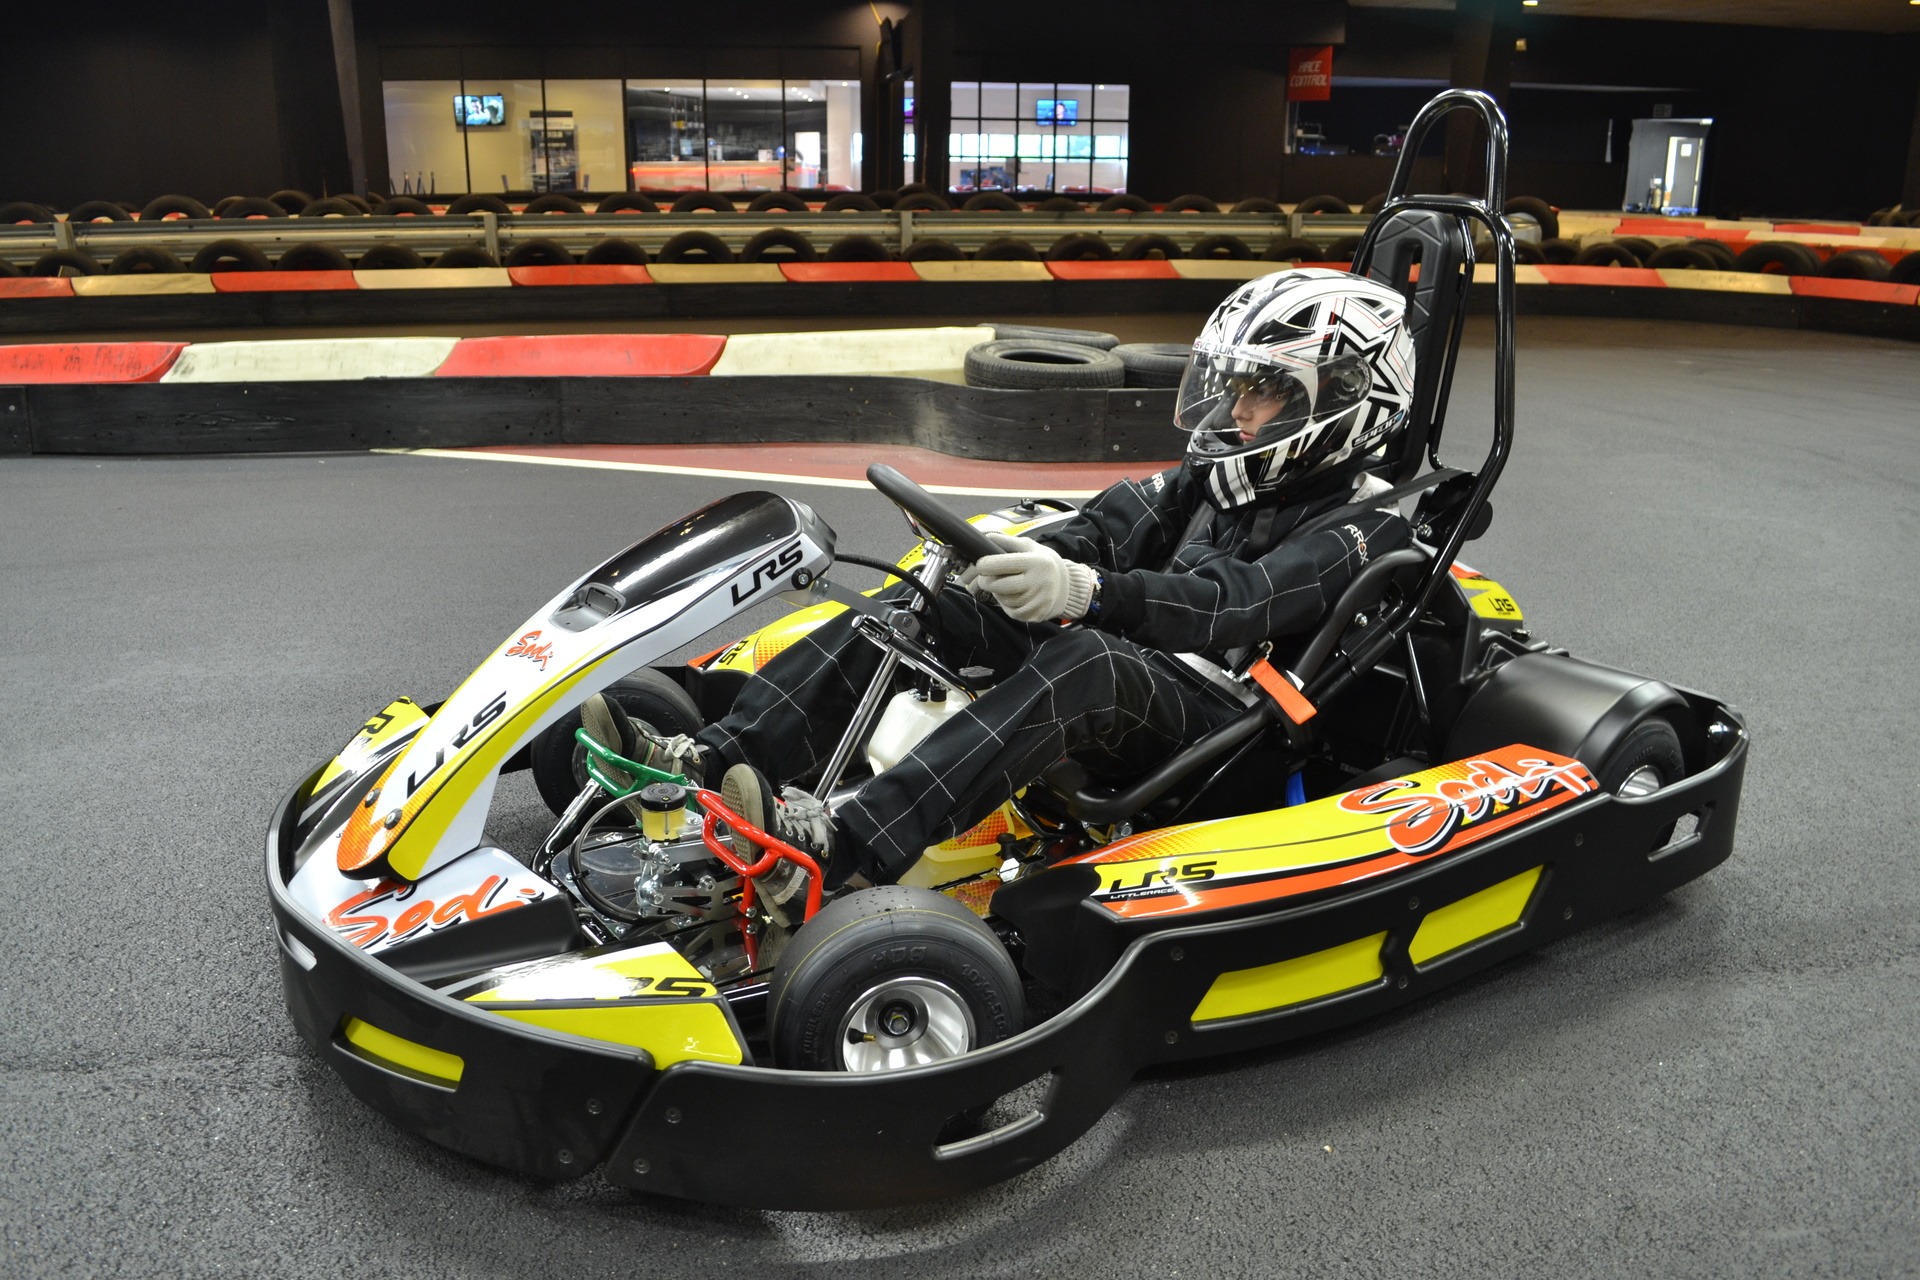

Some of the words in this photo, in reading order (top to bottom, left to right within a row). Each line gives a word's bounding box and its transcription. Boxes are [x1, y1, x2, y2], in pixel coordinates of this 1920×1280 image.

[1289, 74, 1328, 87] CONTROL
[731, 540, 803, 607] LRS
[1488, 598, 1515, 612] LRS
[407, 690, 507, 799] LRS
[1337, 759, 1593, 855] Sodi
[1109, 861, 1218, 893] LRS
